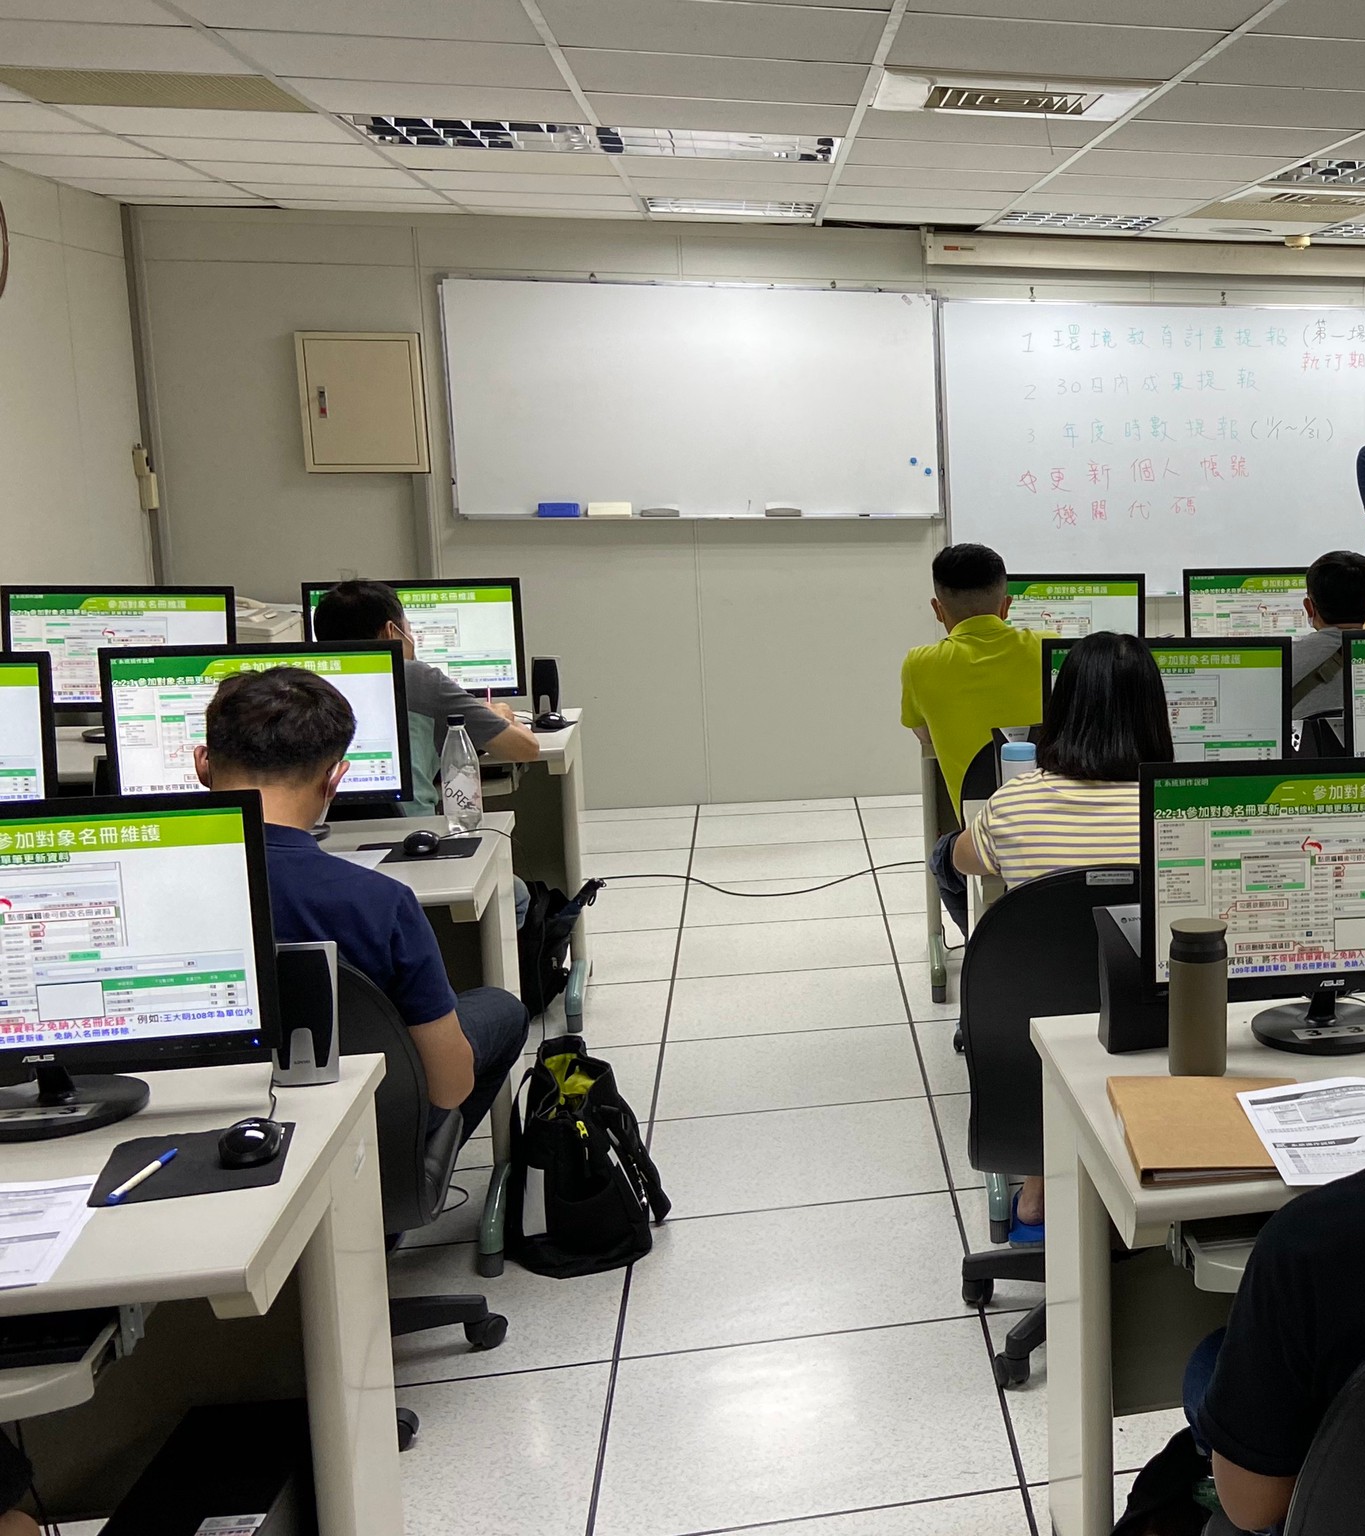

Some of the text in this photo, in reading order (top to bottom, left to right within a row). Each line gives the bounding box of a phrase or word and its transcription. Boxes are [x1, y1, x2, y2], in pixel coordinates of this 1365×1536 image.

[1186, 803, 1280, 819] 參加對象名冊更新
[0, 824, 161, 850] 參加對象名冊維護
[1319, 979, 1345, 988] ASUS
[21, 1053, 56, 1064] ASUS
